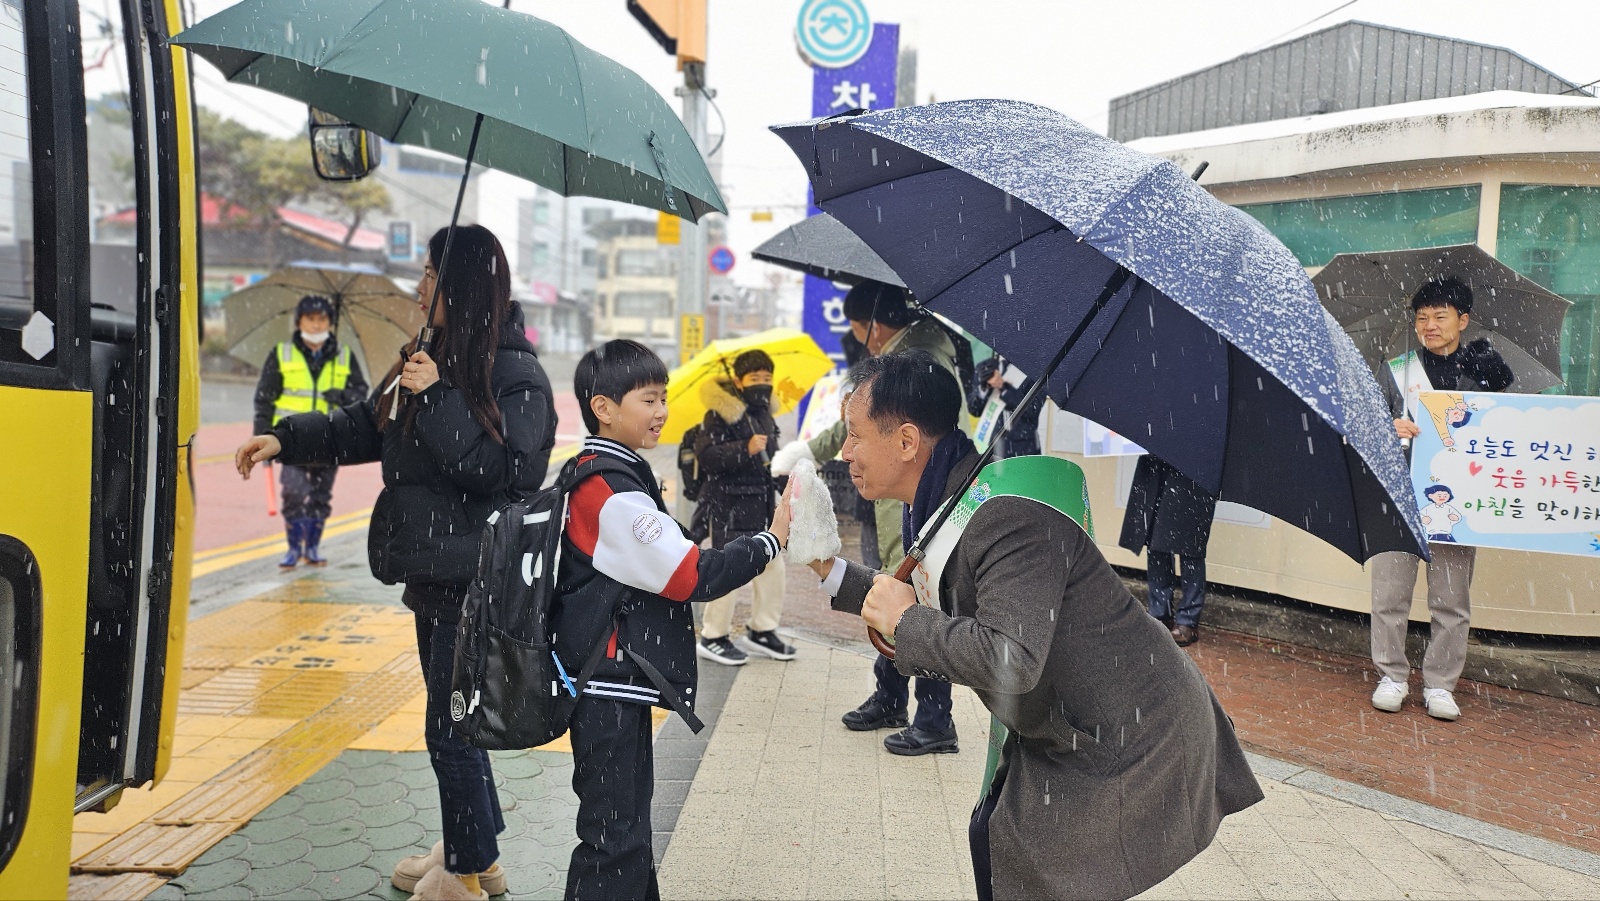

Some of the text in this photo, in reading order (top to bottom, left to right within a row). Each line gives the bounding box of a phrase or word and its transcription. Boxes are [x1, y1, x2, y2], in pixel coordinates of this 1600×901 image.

[1465, 436, 1518, 459] 오늘도
[1530, 440, 1572, 461] 멋진
[1491, 467, 1600, 494] 웃음 가득한
[1464, 496, 1526, 519] 아침을
